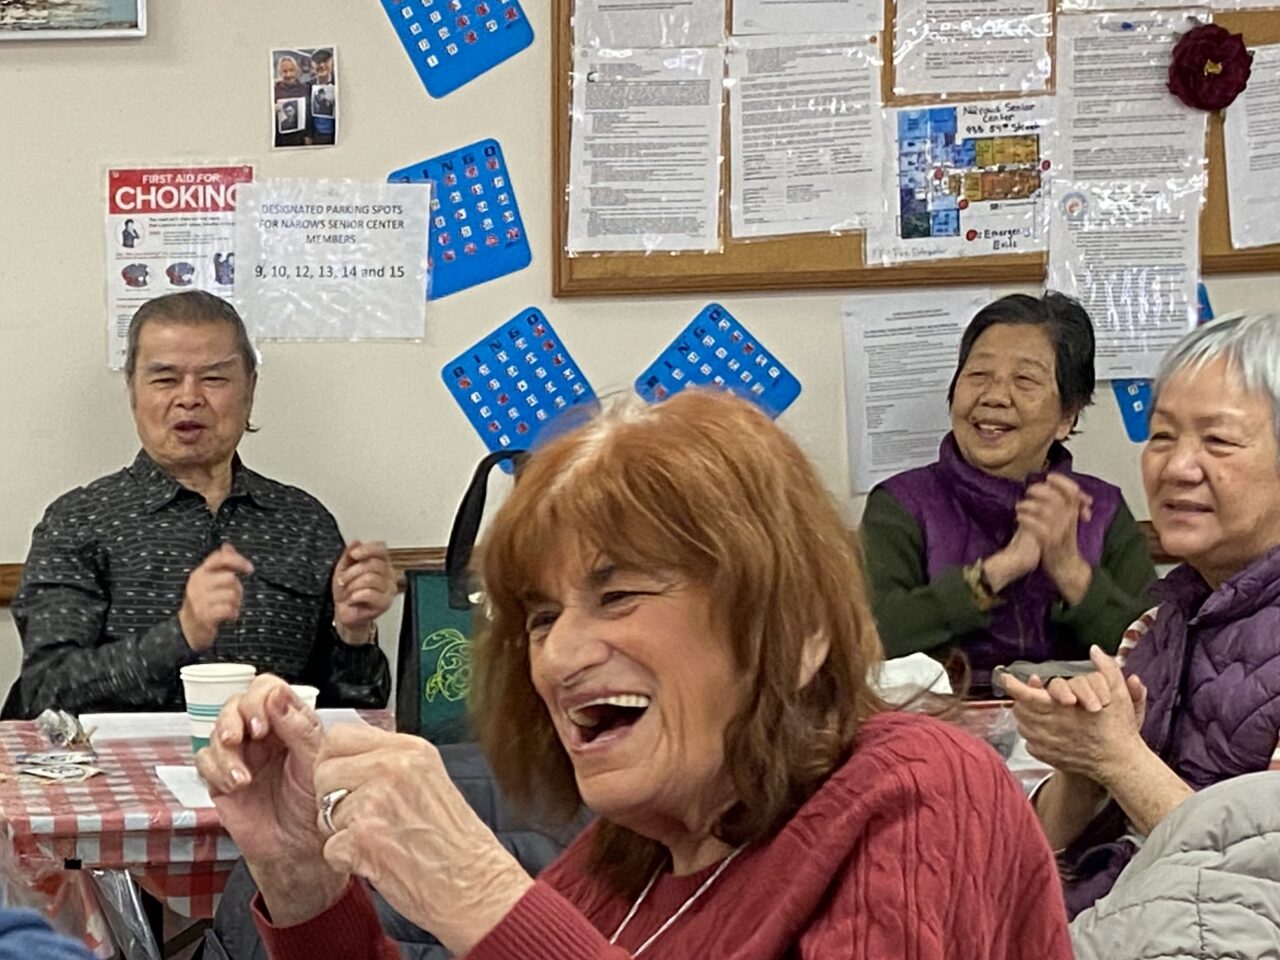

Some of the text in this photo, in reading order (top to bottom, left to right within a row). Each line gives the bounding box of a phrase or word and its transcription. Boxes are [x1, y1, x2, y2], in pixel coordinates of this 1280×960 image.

[142, 173, 220, 184] FIRST AID FOR
[261, 205, 404, 214] DESIGNATED PARKING SPOTS
[259, 220, 404, 229] FOR NAROWS SENIOR CENTER
[306, 235, 356, 243] MEMBERS
[255, 265, 405, 279] 9, 10, 12, 13, 14 and 15
